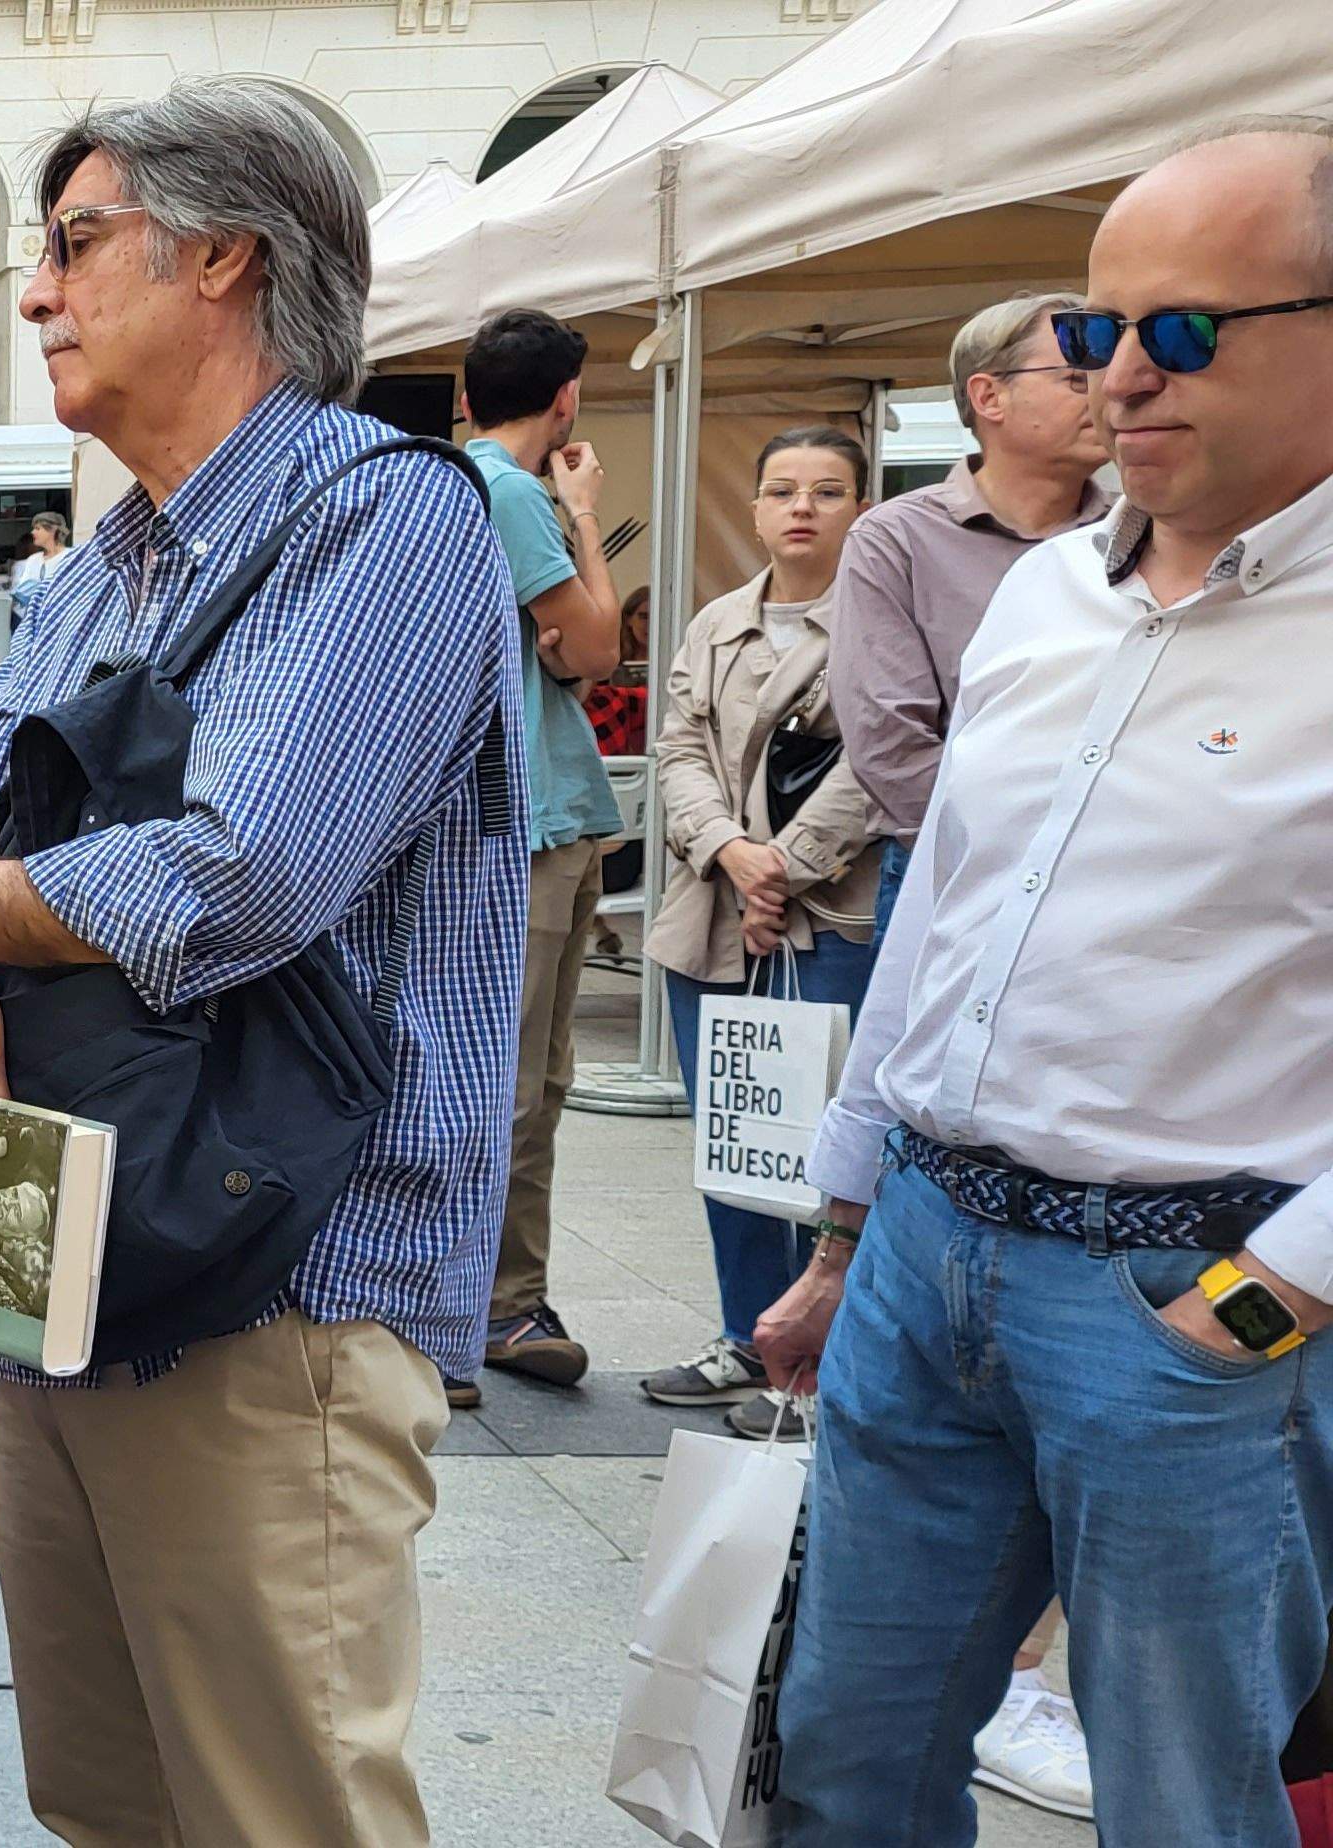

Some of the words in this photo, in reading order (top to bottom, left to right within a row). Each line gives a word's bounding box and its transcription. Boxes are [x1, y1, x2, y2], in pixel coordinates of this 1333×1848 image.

[711, 1018, 783, 1053] FERIA
[710, 1050, 757, 1082] DEL
[709, 1080, 782, 1116] LIBRO
[708, 1112, 741, 1143] DE
[707, 1142, 808, 1186] HUESCA
